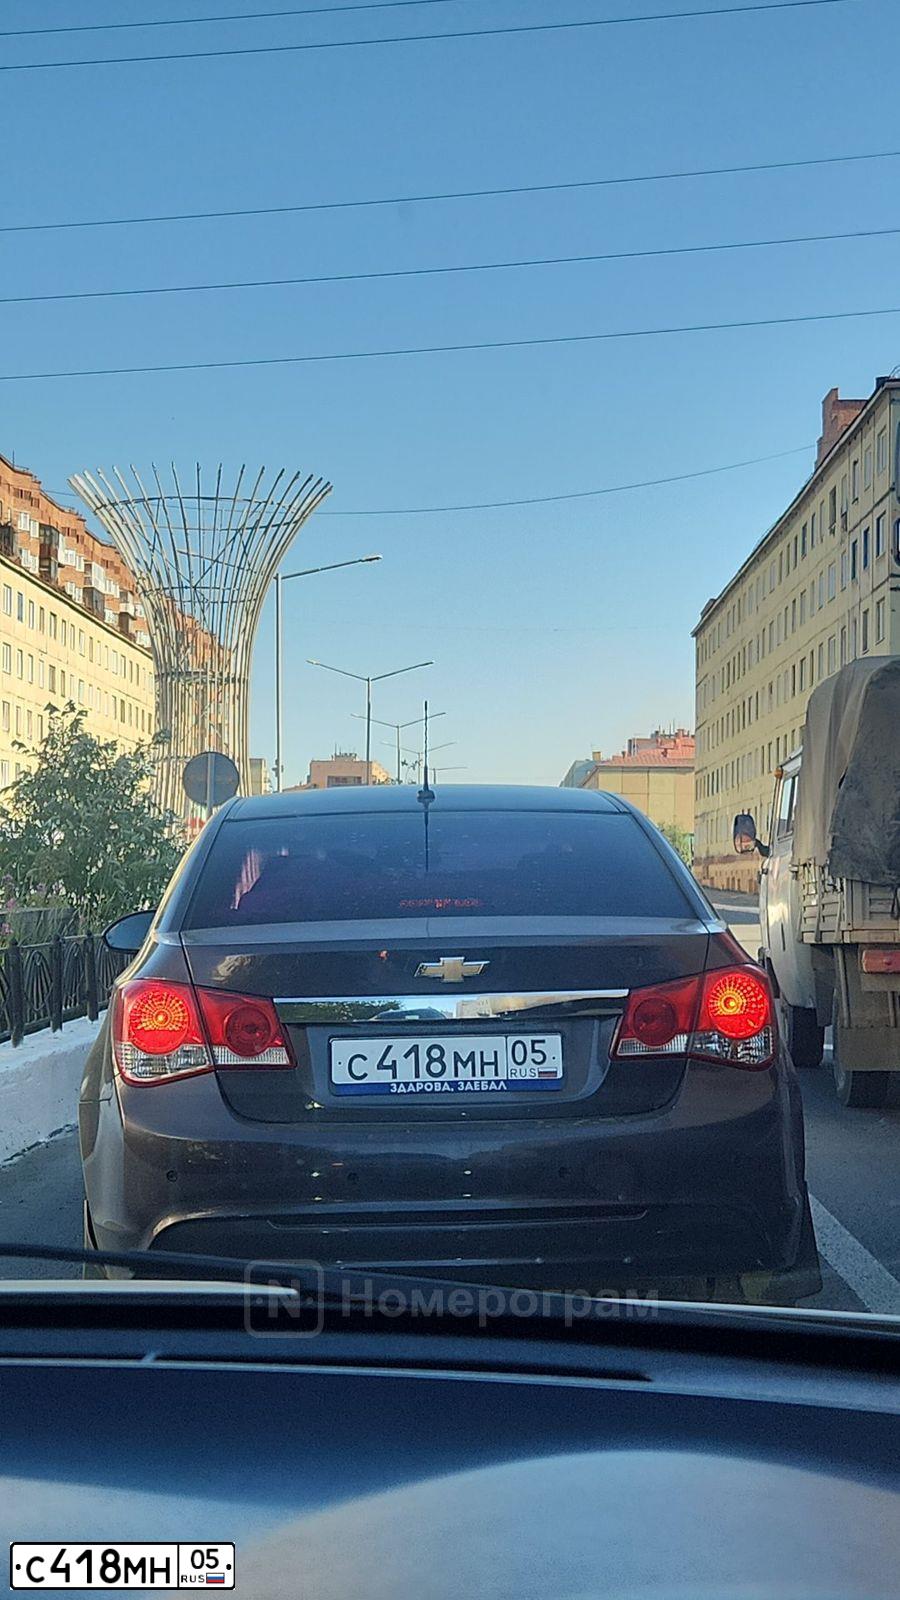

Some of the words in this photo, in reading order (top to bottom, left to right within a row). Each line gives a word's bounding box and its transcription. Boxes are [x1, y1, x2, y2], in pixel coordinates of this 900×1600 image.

[511, 1039, 547, 1066] 05
[509, 1067, 537, 1079] RUS
[457, 1080, 507, 1091] ЗАЕБАЛ
